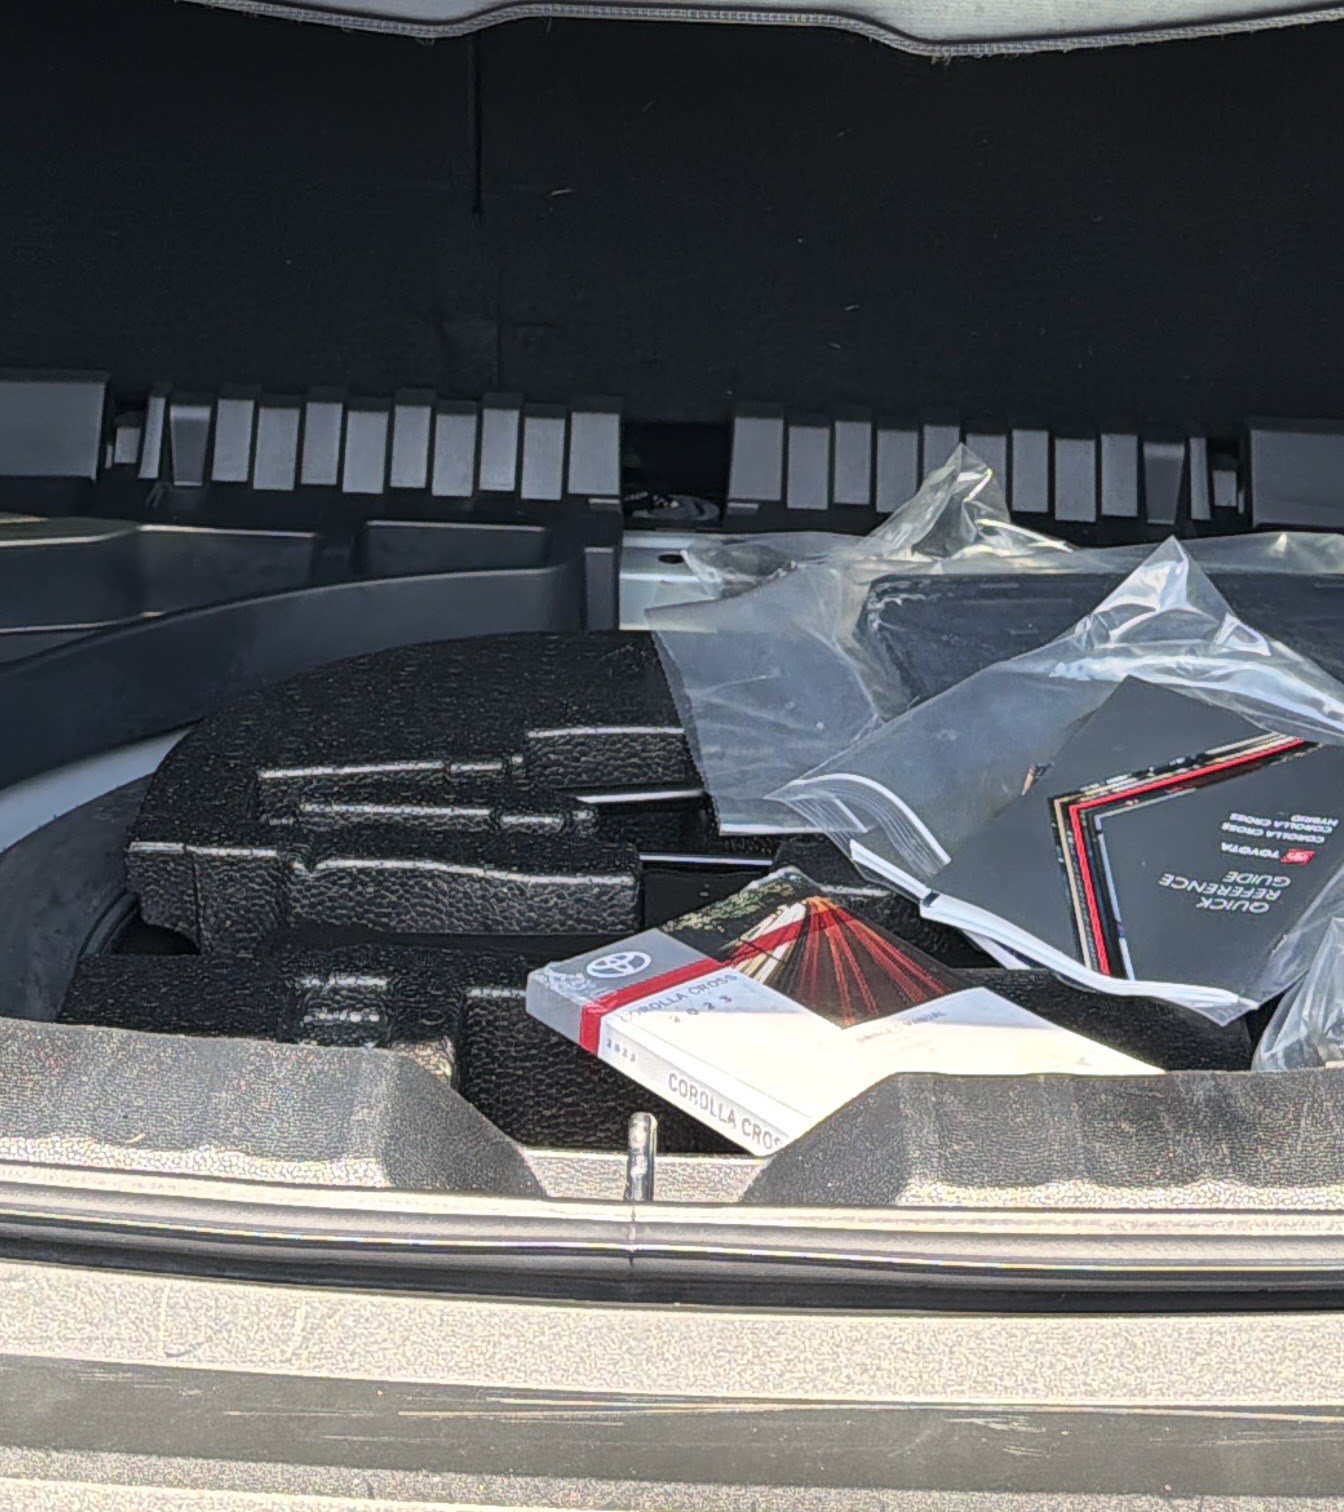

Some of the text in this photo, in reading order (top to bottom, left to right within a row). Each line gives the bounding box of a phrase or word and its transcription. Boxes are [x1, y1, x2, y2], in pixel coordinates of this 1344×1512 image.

[1229, 812, 1333, 834] COROLLA CROSS
[1290, 814, 1340, 827] HYBRID
[1221, 821, 1325, 844] COROLLA CROSS
[1220, 841, 1280, 859] TOYOTA
[1158, 873, 1282, 901] REFERENCE
[1222, 871, 1292, 887] GUIDE
[1195, 896, 1270, 914] QUICK
[668, 1072, 737, 1129] COROLLA
